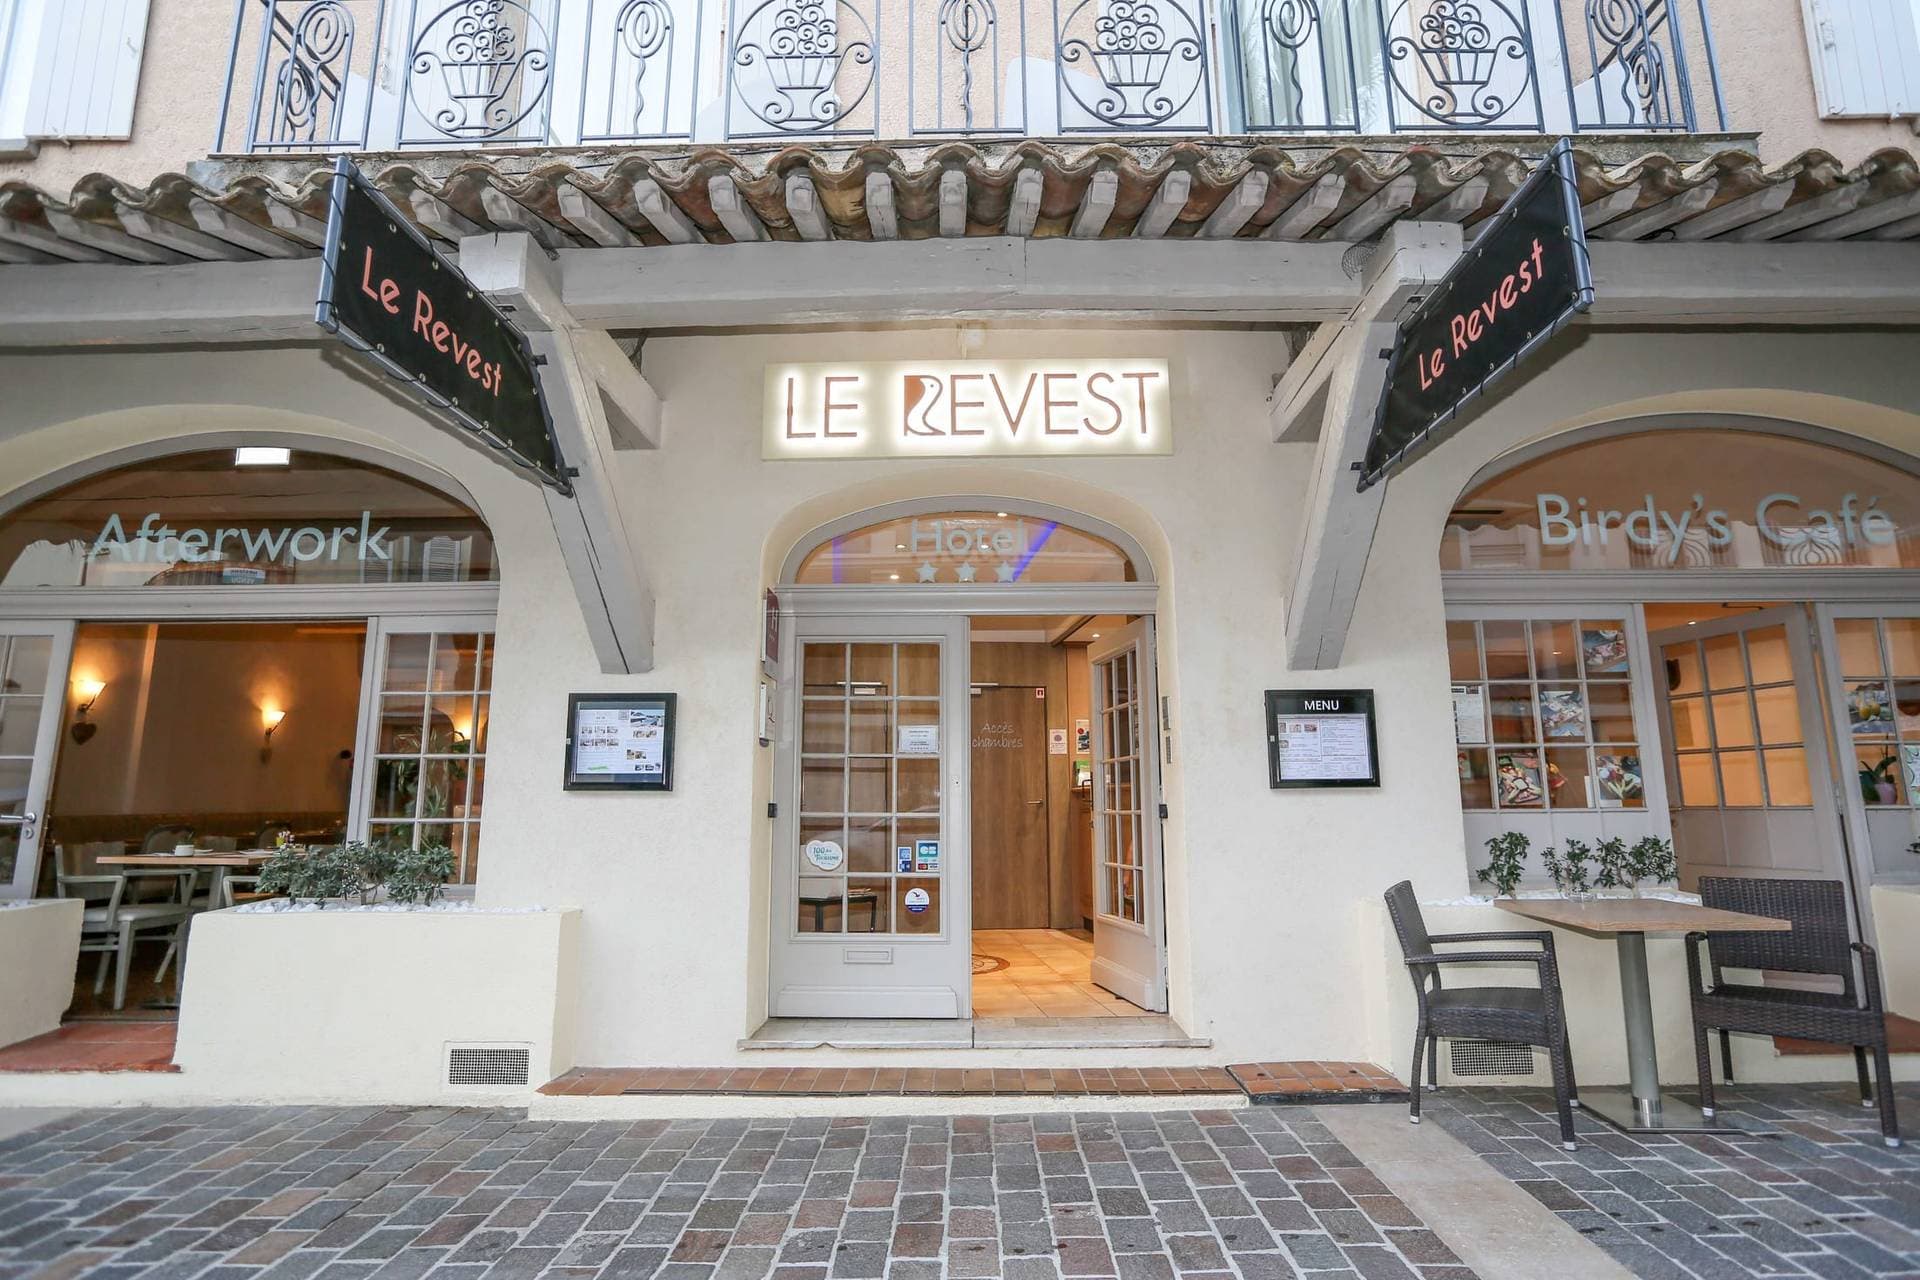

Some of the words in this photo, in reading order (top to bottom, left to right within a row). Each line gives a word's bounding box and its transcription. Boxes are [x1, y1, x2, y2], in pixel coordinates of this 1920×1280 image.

[361, 246, 401, 314] Le
[412, 289, 504, 396] Revest
[1418, 347, 1446, 392] Le
[1451, 237, 1544, 359] Revest
[786, 376, 859, 439] LE
[903, 371, 1160, 437] REVEST
[88, 510, 391, 563] Afterwork
[1536, 492, 1735, 563] Birdy's
[1755, 491, 1897, 547] Café
[1304, 700, 1339, 711] MENU
[971, 735, 1024, 749] chambres
